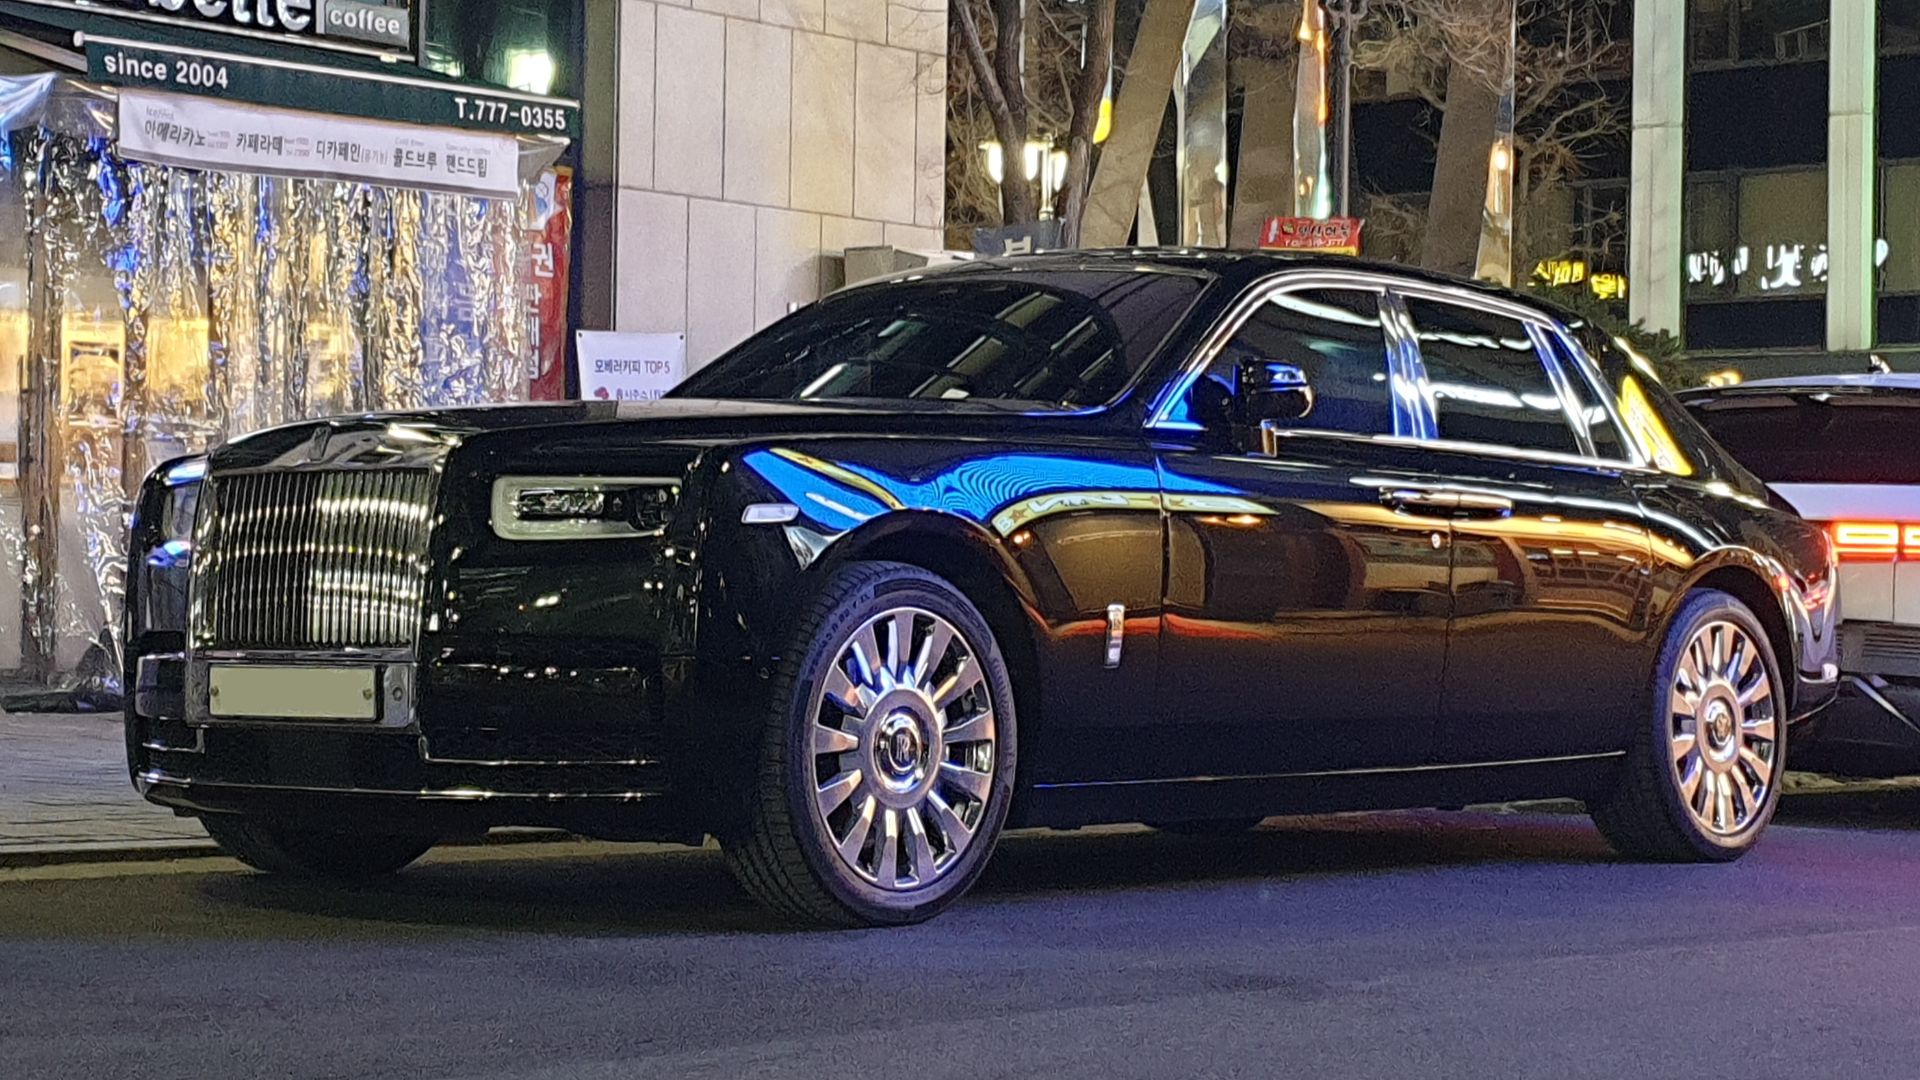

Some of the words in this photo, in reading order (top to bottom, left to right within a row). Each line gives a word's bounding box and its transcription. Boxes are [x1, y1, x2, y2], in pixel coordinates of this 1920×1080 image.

[330, 8, 400, 35] coffee
[103, 51, 167, 80] since
[175, 60, 229, 89] 2004
[454, 97, 567, 131] T.777-0355
[144, 120, 207, 148] 아메리카노
